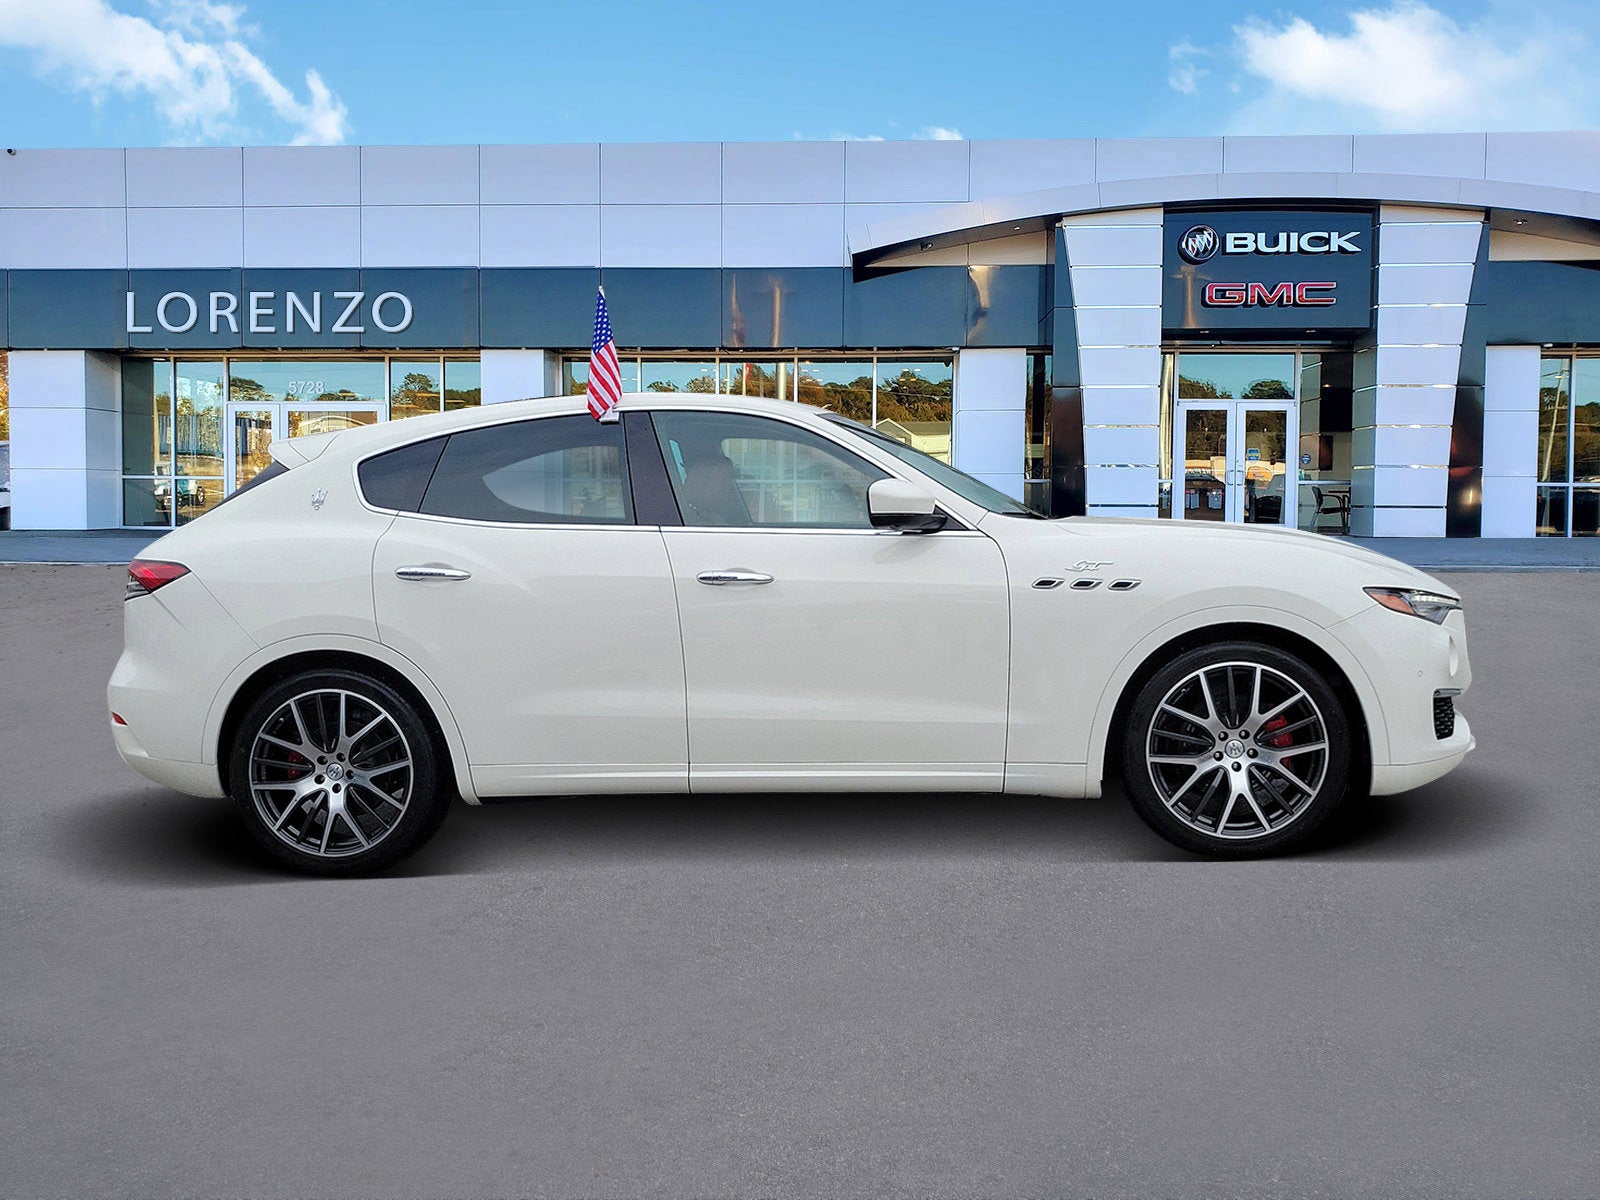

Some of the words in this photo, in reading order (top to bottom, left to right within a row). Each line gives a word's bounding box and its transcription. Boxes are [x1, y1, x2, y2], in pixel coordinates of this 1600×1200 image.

[1225, 231, 1362, 253] BUICK
[1206, 281, 1337, 305] GMC
[126, 291, 413, 333] LORENZO
[288, 380, 325, 394] 5728
